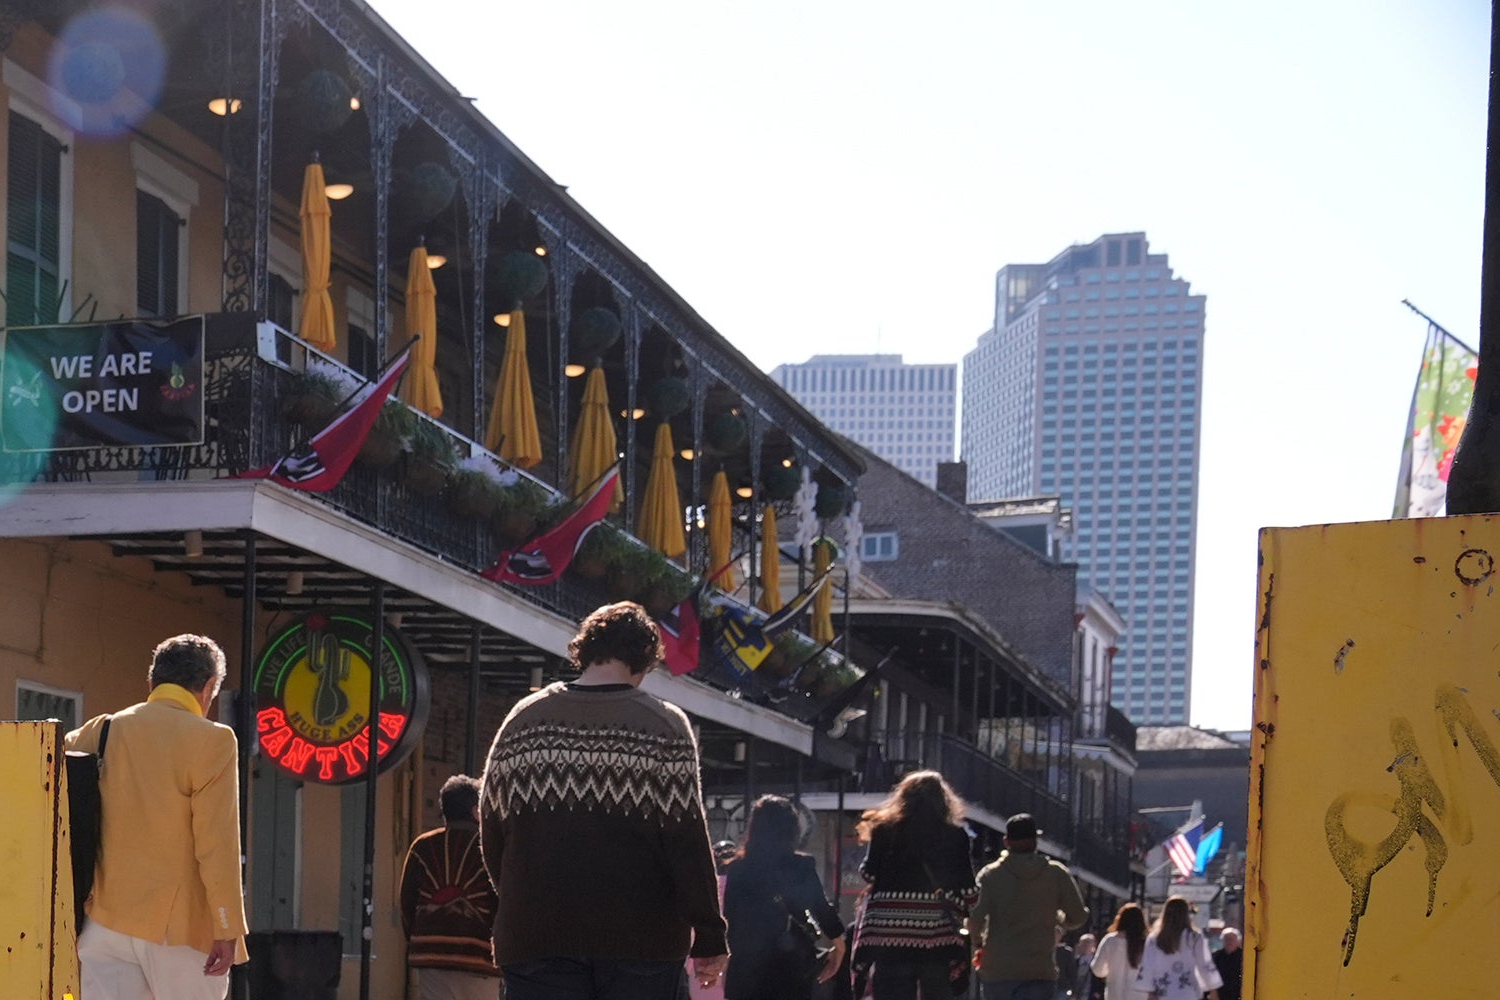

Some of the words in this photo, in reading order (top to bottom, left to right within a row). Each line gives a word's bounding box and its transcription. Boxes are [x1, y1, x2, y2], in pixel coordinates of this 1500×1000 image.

[50, 355, 93, 379] WE
[100, 351, 153, 377] ARE
[62, 388, 138, 413] OPEN
[265, 658, 283, 687] LIVE
[281, 633, 307, 659] LIFE
[290, 711, 331, 740] HUGE
[339, 713, 364, 737] ASS
